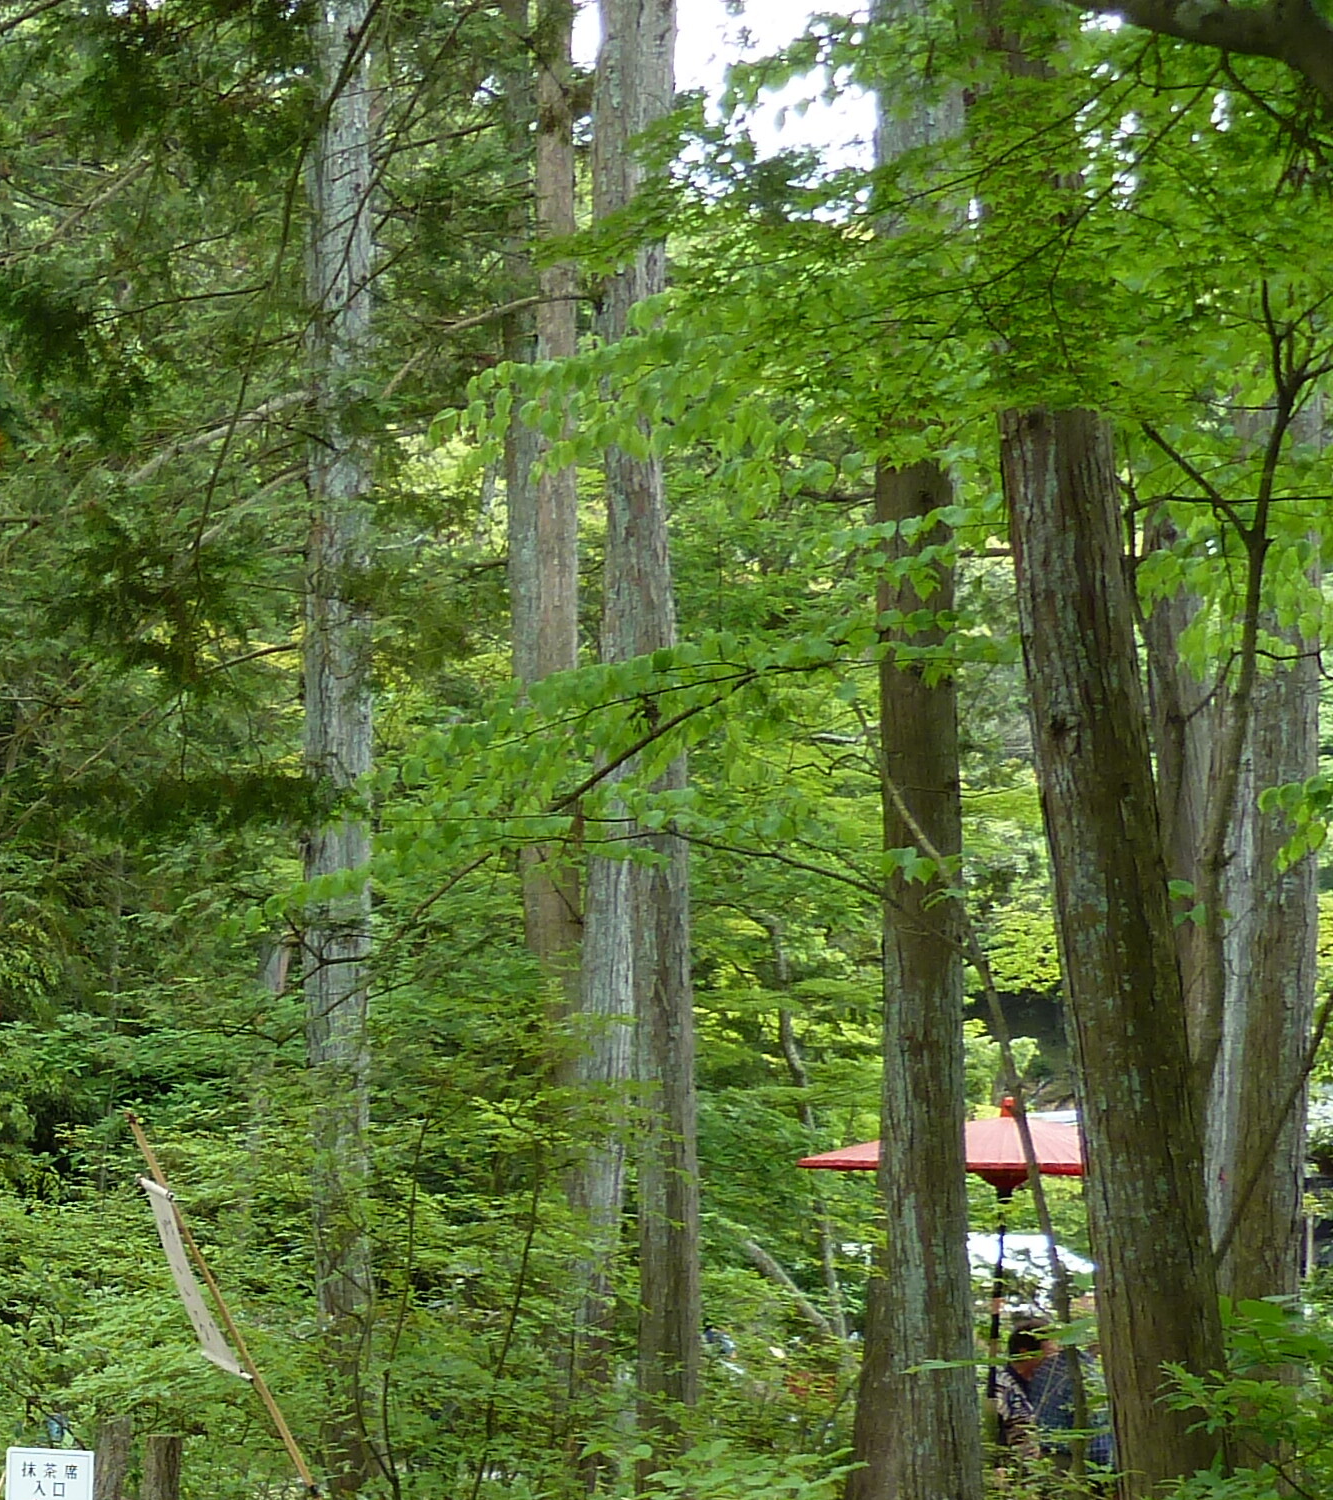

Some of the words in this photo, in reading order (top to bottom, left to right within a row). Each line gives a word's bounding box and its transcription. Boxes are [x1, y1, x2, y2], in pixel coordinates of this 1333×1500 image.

[21, 1461, 79, 1479] 抹茶席
[33, 1480, 65, 1497] 入口
